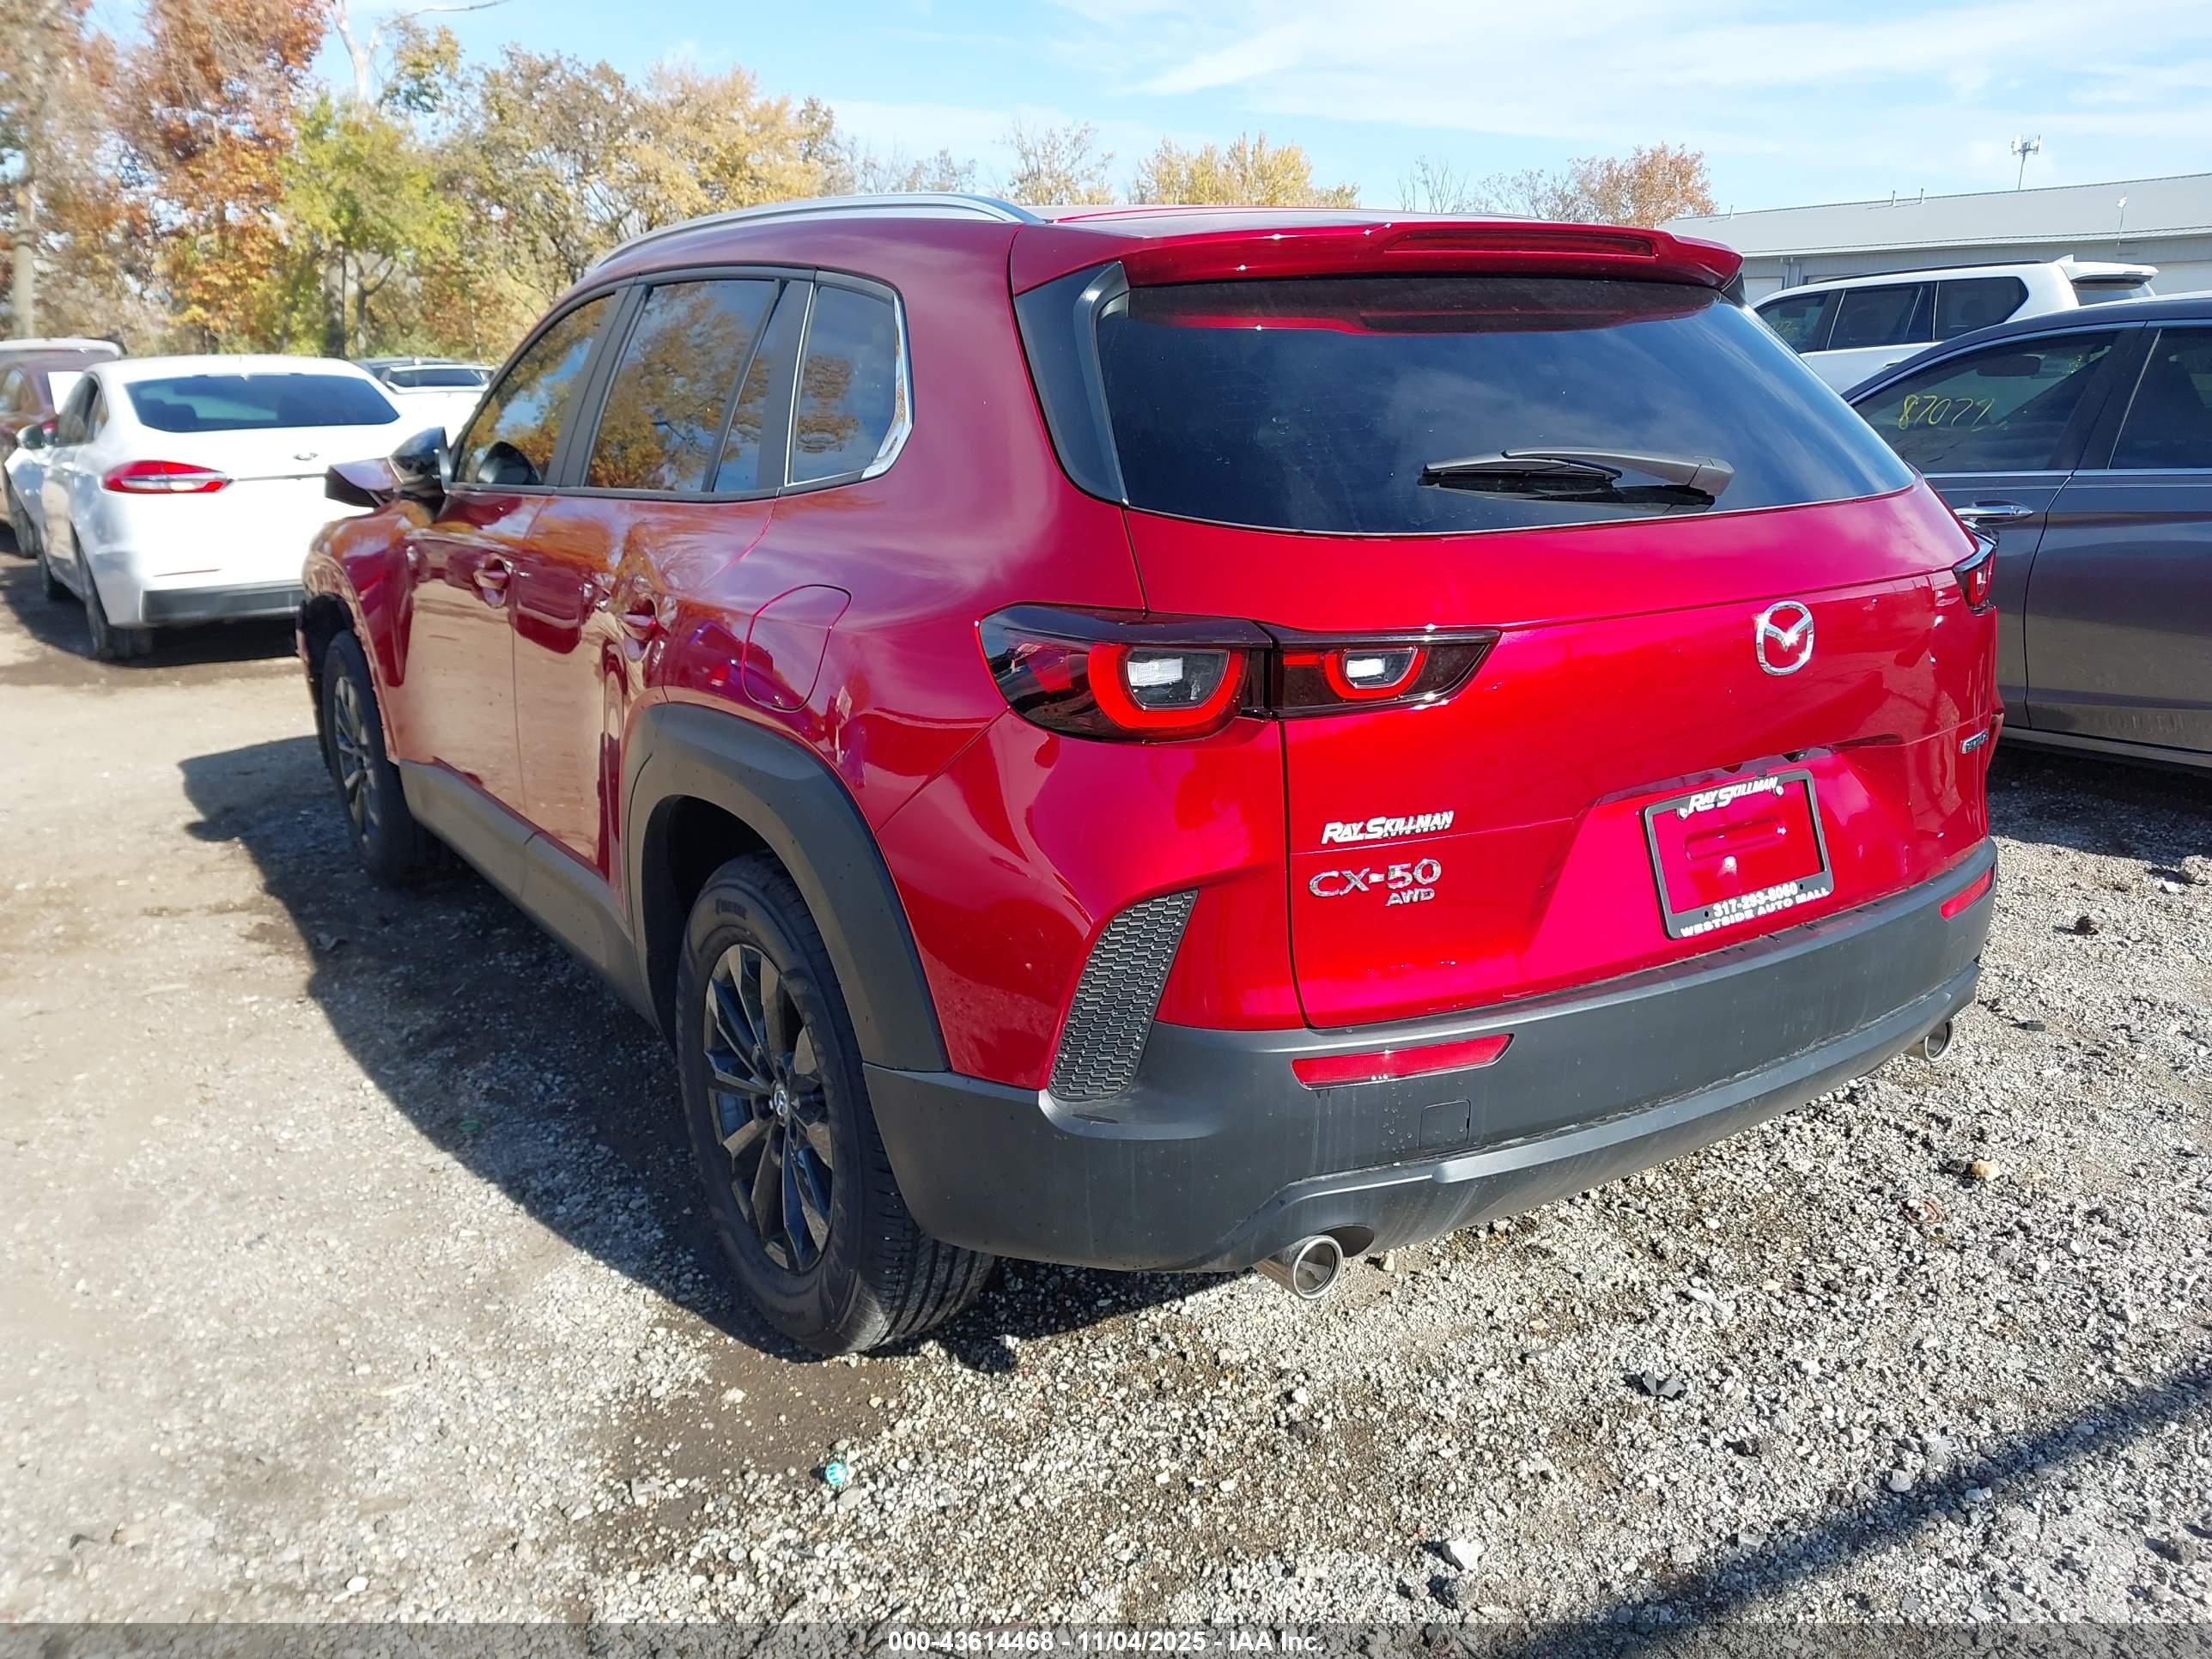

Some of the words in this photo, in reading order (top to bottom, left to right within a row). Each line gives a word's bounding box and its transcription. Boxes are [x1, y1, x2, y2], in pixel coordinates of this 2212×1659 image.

[1687, 790, 1718, 813] RAY
[1717, 776, 1778, 808] SKILLMAN
[1322, 821, 1366, 844] RAY
[1365, 811, 1454, 839] SKILLMAN
[1309, 859, 1442, 896] CX-50
[1385, 888, 1435, 906] AWD
[1680, 908, 1755, 937] WESTSIDE
[1757, 898, 1794, 916] AUTO
[1796, 887, 1831, 904] MALL
